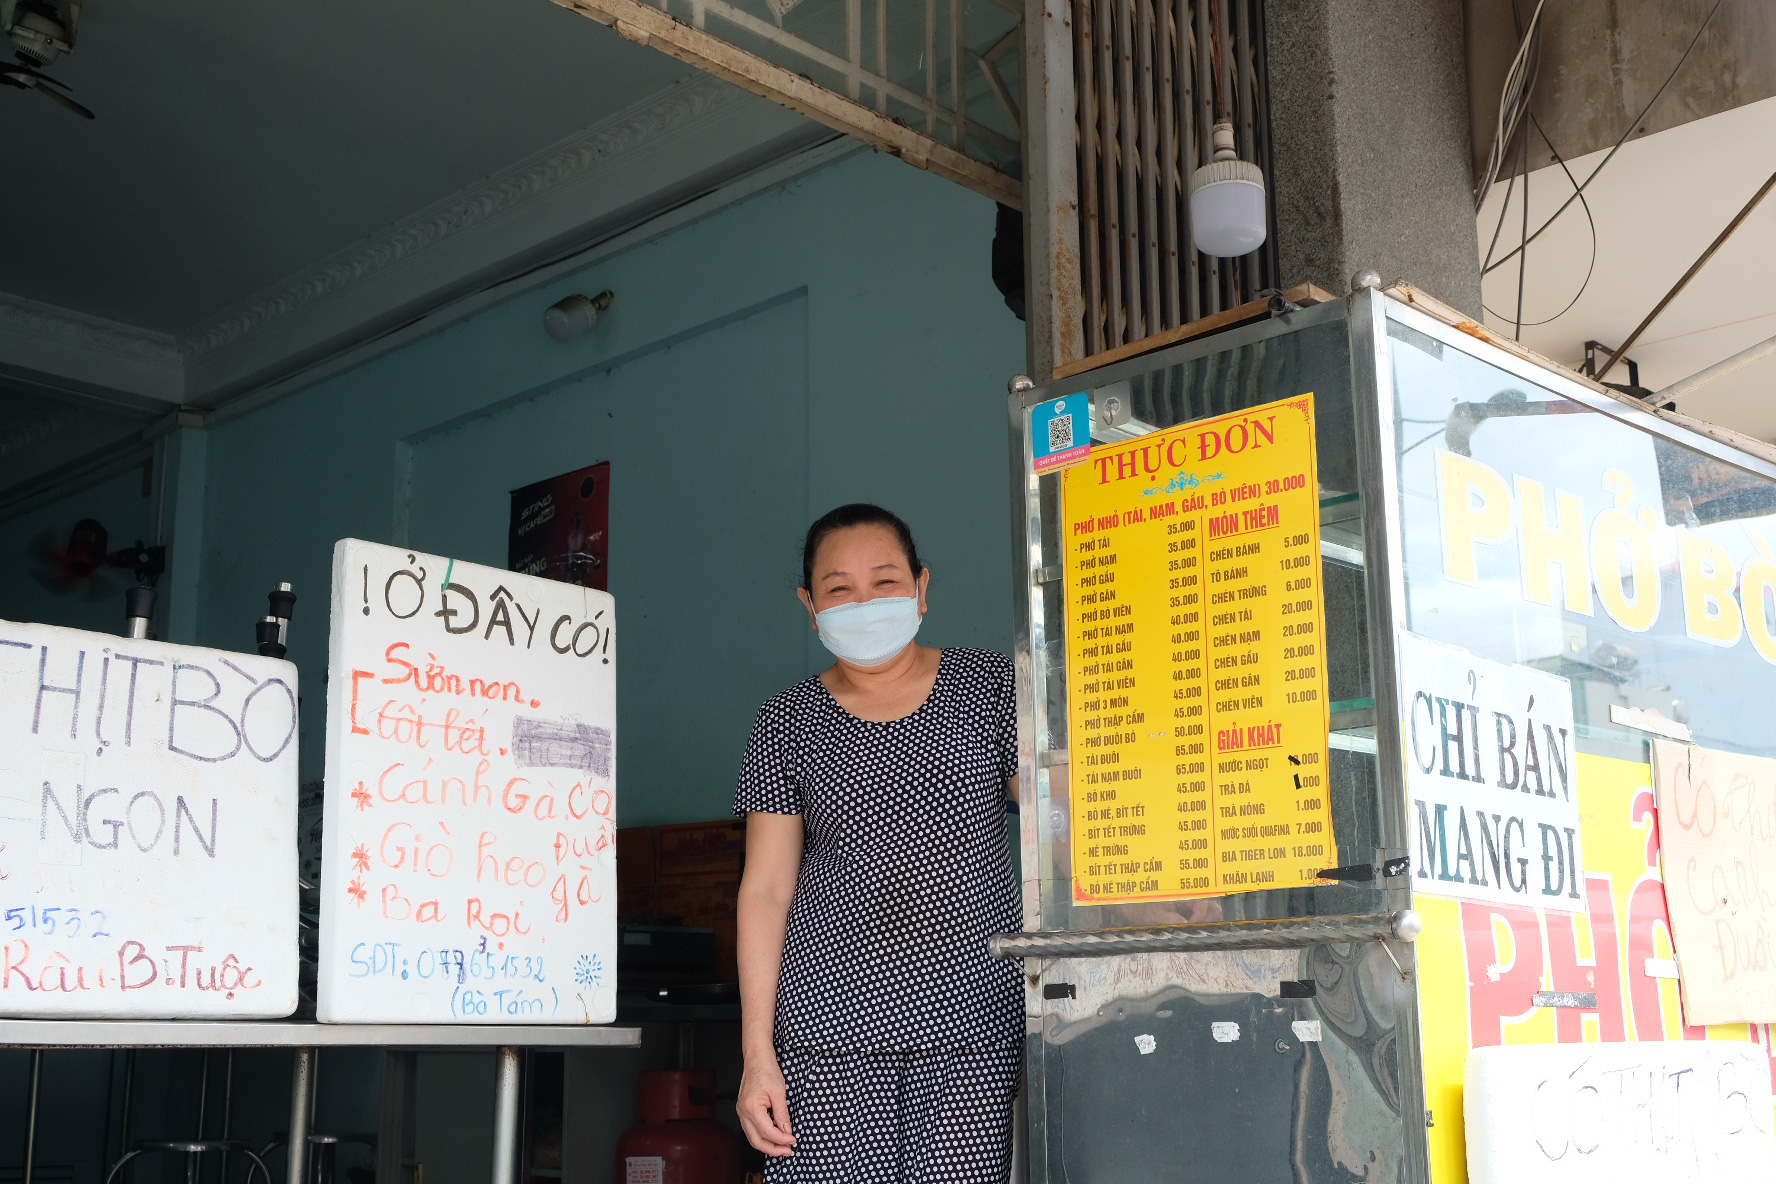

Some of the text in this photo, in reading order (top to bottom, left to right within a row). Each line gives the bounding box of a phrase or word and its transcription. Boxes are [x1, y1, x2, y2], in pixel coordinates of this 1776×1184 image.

[1093, 415, 1276, 486] THỰC ĐƠN
[520, 493, 552, 520] STING
[1073, 514, 1094, 536] PHỞ
[1097, 509, 1119, 531] NHỎ
[1122, 506, 1146, 527] (TÁI,
[1149, 501, 1178, 521] NẠM,
[1211, 487, 1227, 507] BÒ
[1229, 482, 1261, 502] VIÊN)
[1264, 473, 1305, 495] 30.000
[1208, 502, 1279, 538] MÓN THÊM
[1079, 519, 1195, 553] PHỞ TÁI 35.000
[1209, 532, 1309, 562] CHÉN BÁNH 5.000
[1434, 446, 1664, 634] PHỞ
[1079, 537, 1196, 570] PHỞ NẠM 35.000
[1210, 554, 1310, 583] TÔ BÁNH 10.000
[1081, 574, 1197, 606] PHỞ GÂN 35.000
[1211, 589, 1235, 604] CHÉN
[1285, 576, 1311, 592] 6.000
[1081, 592, 1198, 623] PHỞ BÒ VIÊN 35.000
[1212, 599, 1312, 626] CHÉN TÁI 20.000
[434, 583, 541, 650] ĐÂY
[550, 609, 612, 665] CÓ!
[1082, 611, 1199, 641] PHỞ TÁI NẠM 40.000
[1213, 621, 1313, 647] CHÉN NẠM 20.000
[1083, 648, 1200, 676] PHỞ TÁI GÂN 40.000
[1214, 666, 1316, 691] CHÉN GÂN 20.000
[168, 656, 297, 763] BÒ
[1084, 685, 1201, 712] PHỞ 3 MÓN 45.000
[1215, 689, 1317, 713] CHÉN VIÊN 10.000
[1084, 714, 1101, 730] PHỞ
[1102, 713, 1123, 728] THẬP
[1173, 704, 1202, 718] 45.000
[1085, 723, 1203, 748] PHỞ ĐUÔI BÒ 50.000
[1217, 719, 1282, 751] GIẢI KHÁT
[1410, 668, 1571, 804] CHỈ BÁN
[1085, 742, 1204, 766] TÁI ĐUÔI 65.000
[377, 757, 493, 807] Cánh
[1085, 761, 1204, 784] TÁI NẠM ĐUÔI 65.000
[1086, 780, 1205, 803] BÒ KHO 45.000
[40, 780, 218, 859] NGON
[1087, 807, 1098, 821] BÒ
[1100, 806, 1113, 820] NÉ,
[1115, 804, 1128, 818] BÍT
[1177, 799, 1206, 812] 40.000
[1219, 798, 1321, 817] TRÀ NÓNG 1.000
[1087, 825, 1100, 839] BÍT
[1178, 818, 1207, 832] 45.000
[1259, 823, 1290, 838] QUAFINA
[1295, 821, 1322, 834] 7.000
[379, 820, 547, 889] Giò heo
[1088, 844, 1099, 857] NÉ
[1178, 837, 1207, 851] 45.000
[1221, 844, 1323, 862] BIA TIGER LON 18.000
[1413, 798, 1581, 900] MANG ĐI
[1222, 869, 1274, 886] KHĂN LẠNH
[381, 882, 448, 924] Ba
[549, 864, 602, 924] gà
[450, 985, 560, 1020] (Bà Tám)
